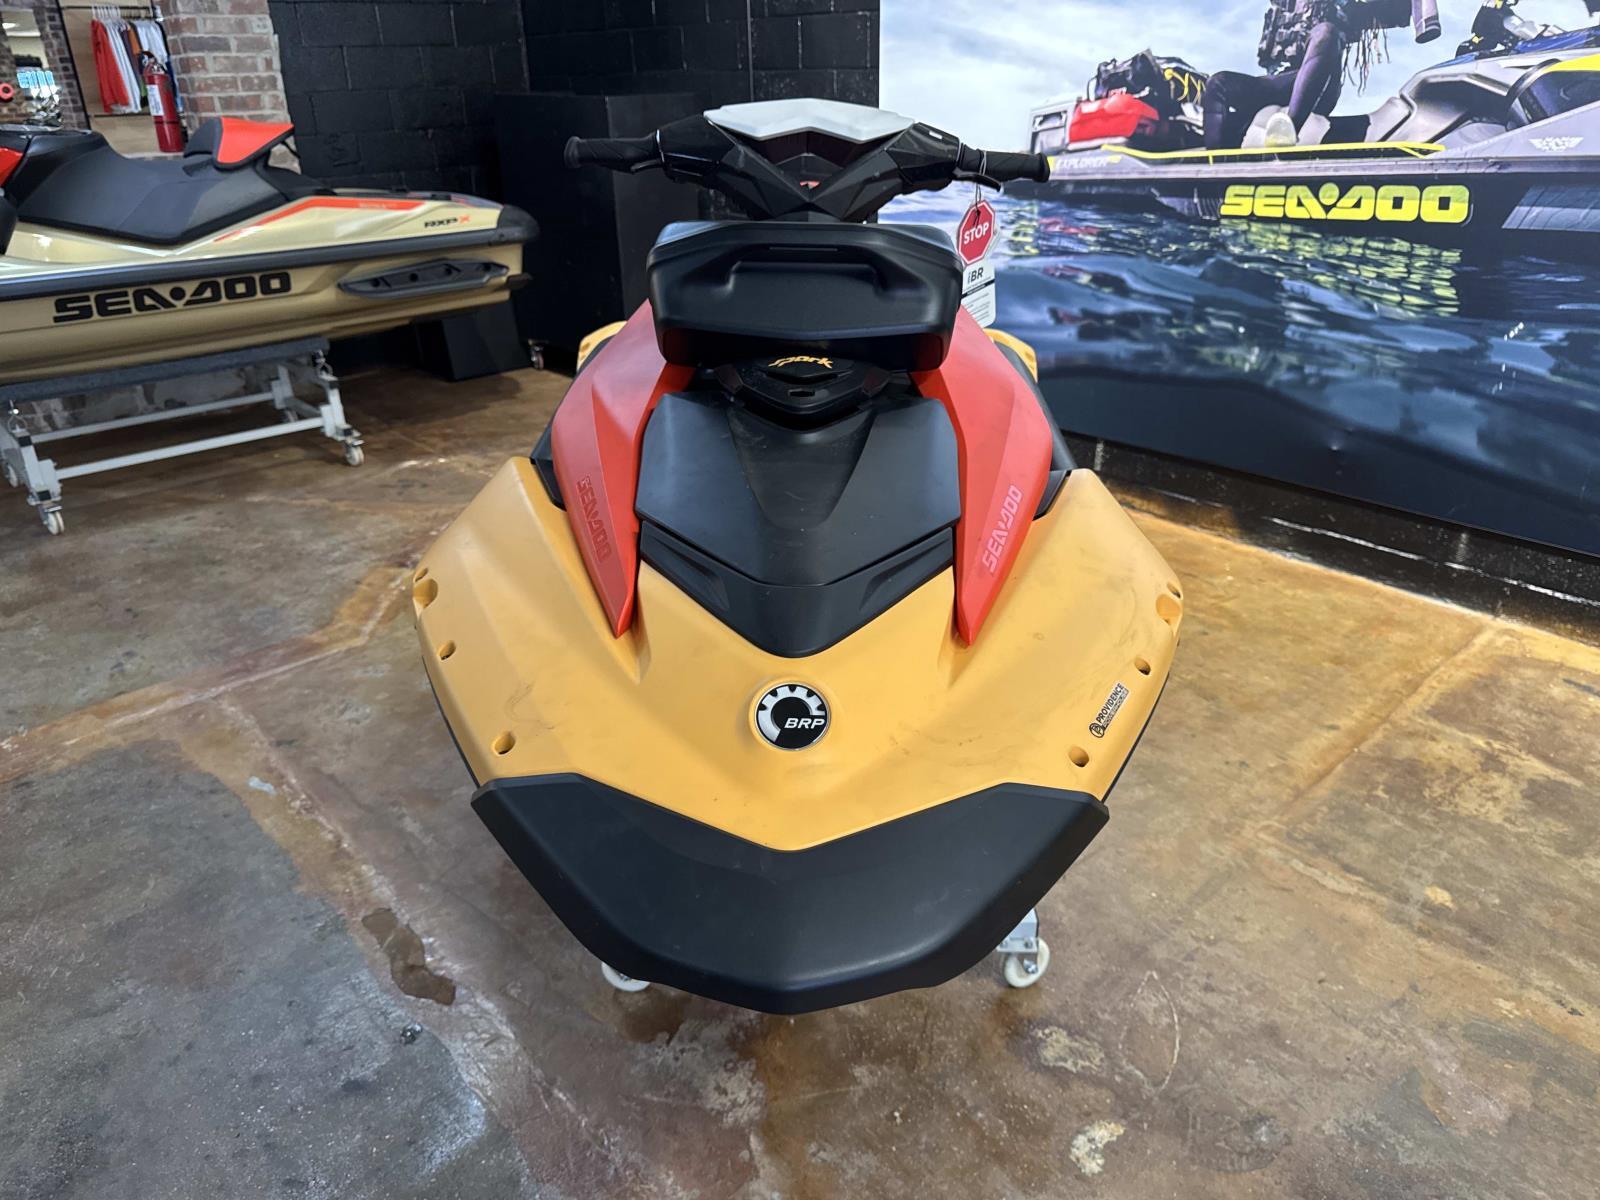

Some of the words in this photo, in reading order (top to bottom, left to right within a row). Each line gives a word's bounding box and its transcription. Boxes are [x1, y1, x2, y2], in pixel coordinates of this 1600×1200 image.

[963, 222, 990, 245] STOP
[1095, 682, 1124, 724] PROVIDENCE
[784, 717, 825, 729] BRP
